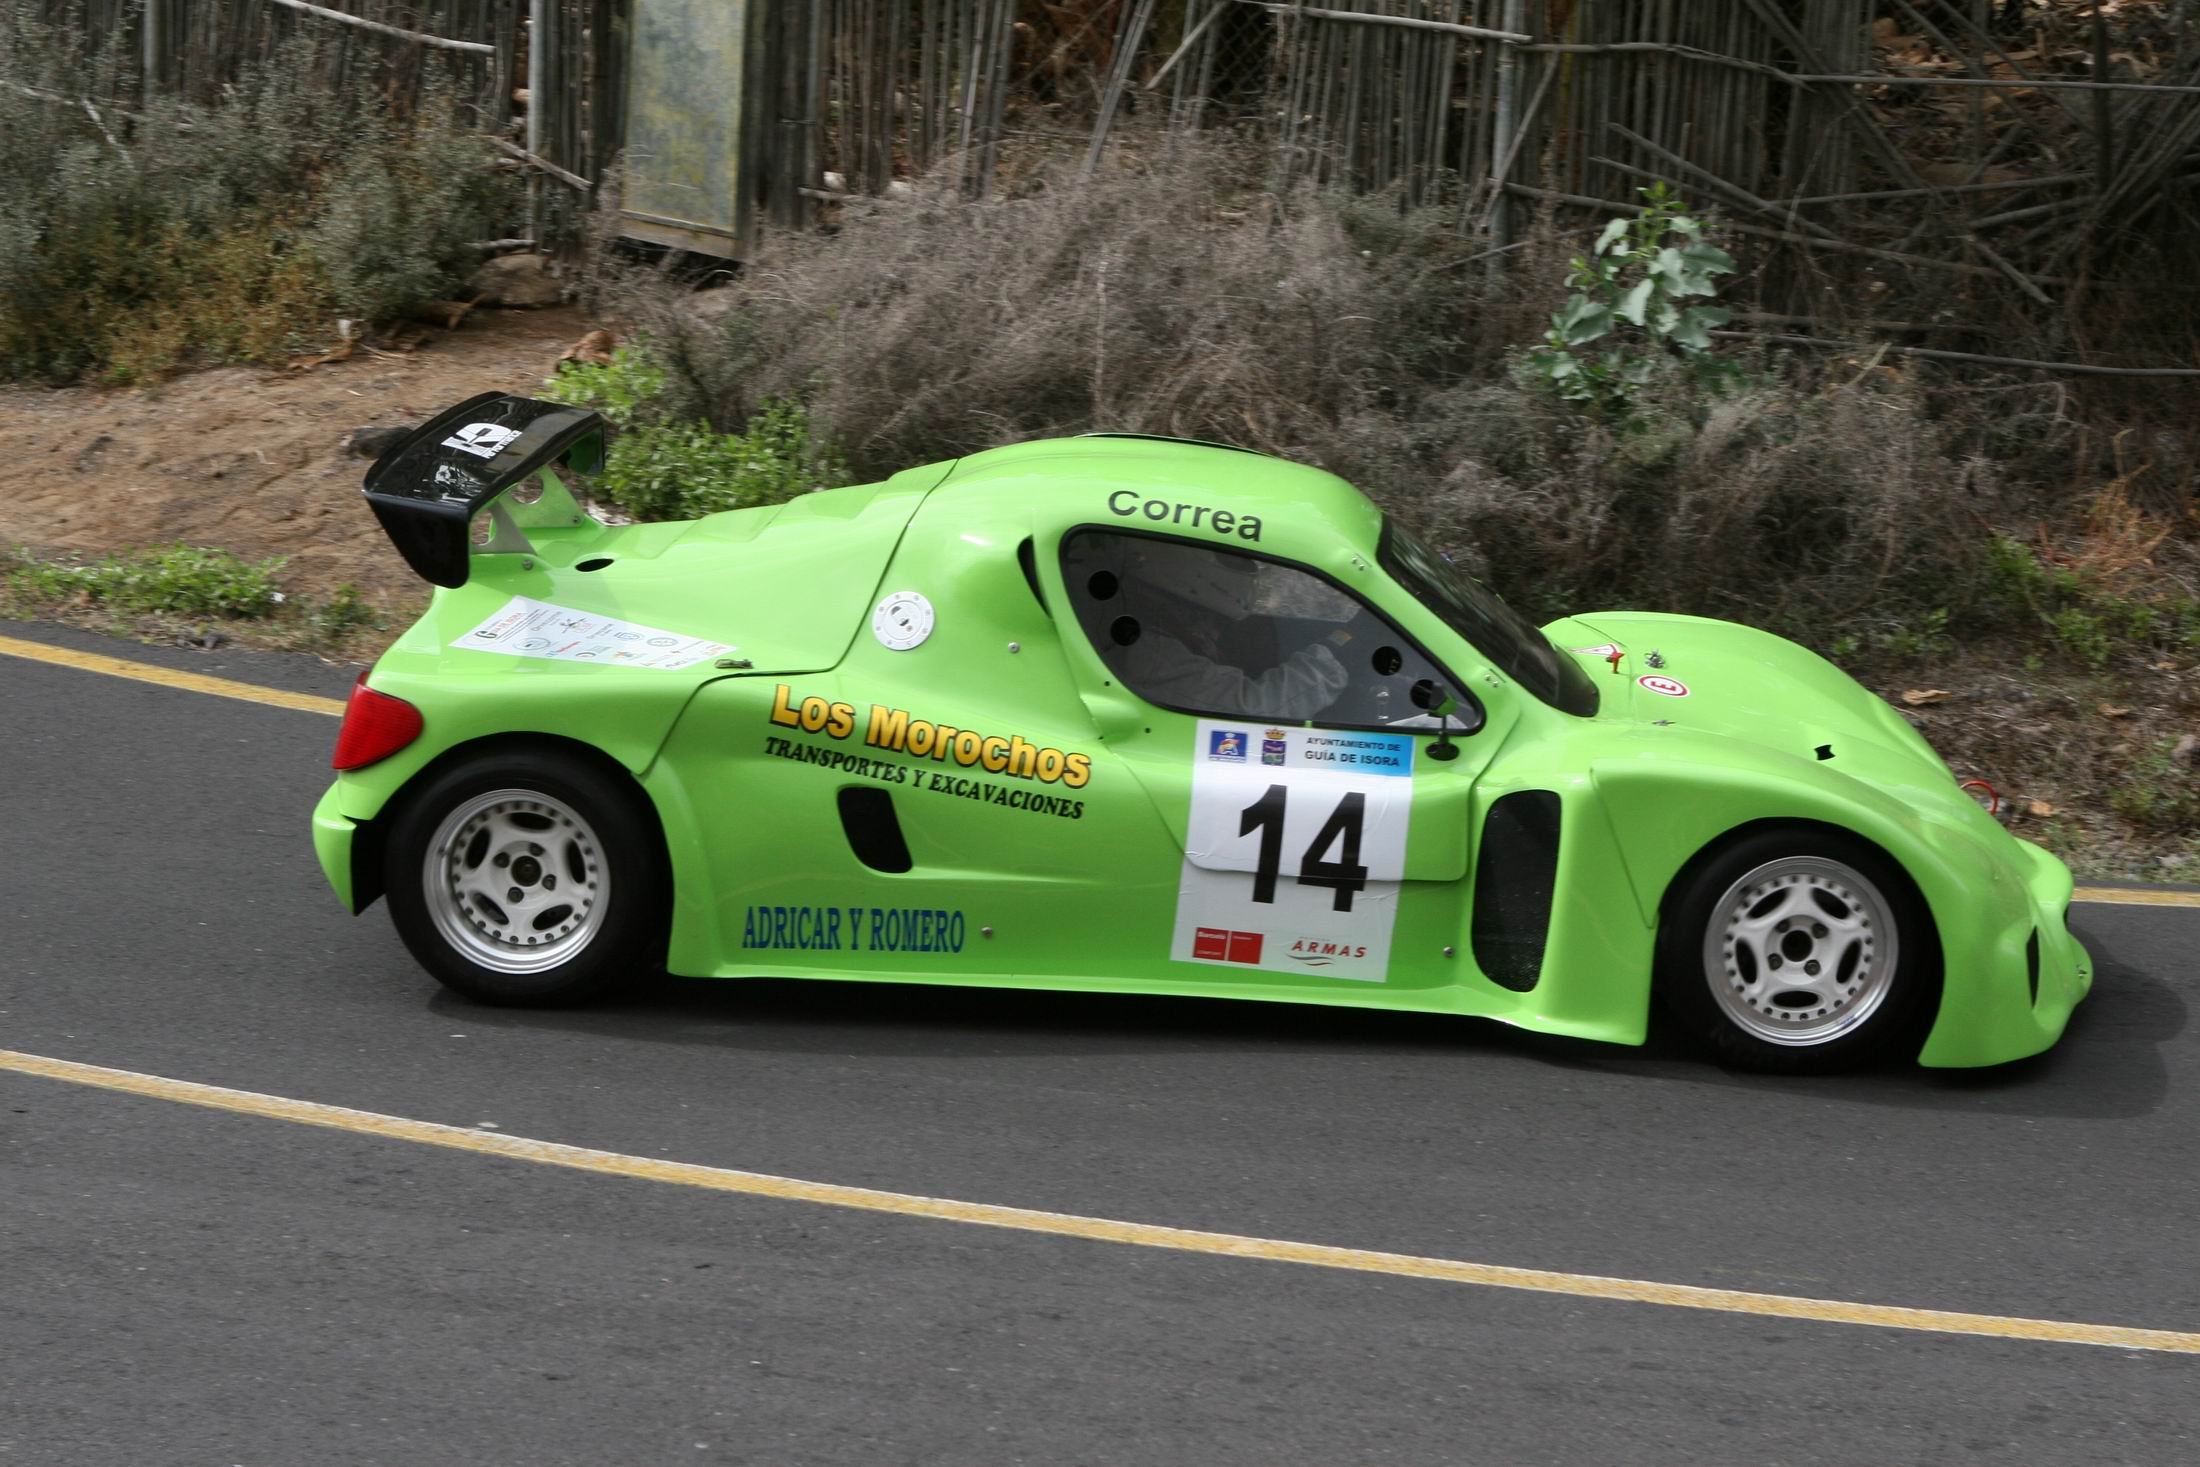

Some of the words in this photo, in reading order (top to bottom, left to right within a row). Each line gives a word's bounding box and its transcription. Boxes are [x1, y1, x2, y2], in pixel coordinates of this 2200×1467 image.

[1107, 490, 1263, 543] Correa
[770, 684, 855, 739] Los
[864, 704, 1092, 789] Morochos
[1304, 749, 1337, 762] GUÍA
[1340, 753, 1357, 763] DE
[1361, 754, 1401, 767] ISORA
[1306, 737, 1386, 751] AYUNTAMIENTO
[1387, 743, 1401, 752] DE
[765, 736, 908, 784] TRANSPORTES
[912, 769, 925, 788] Y
[928, 773, 1085, 820] EXCAVACIONES
[1239, 784, 1369, 913] 14
[742, 906, 842, 950] ADRICAR
[848, 908, 864, 950] Y
[869, 908, 966, 953] ROMERO
[1291, 940, 1367, 958] ARMAS
